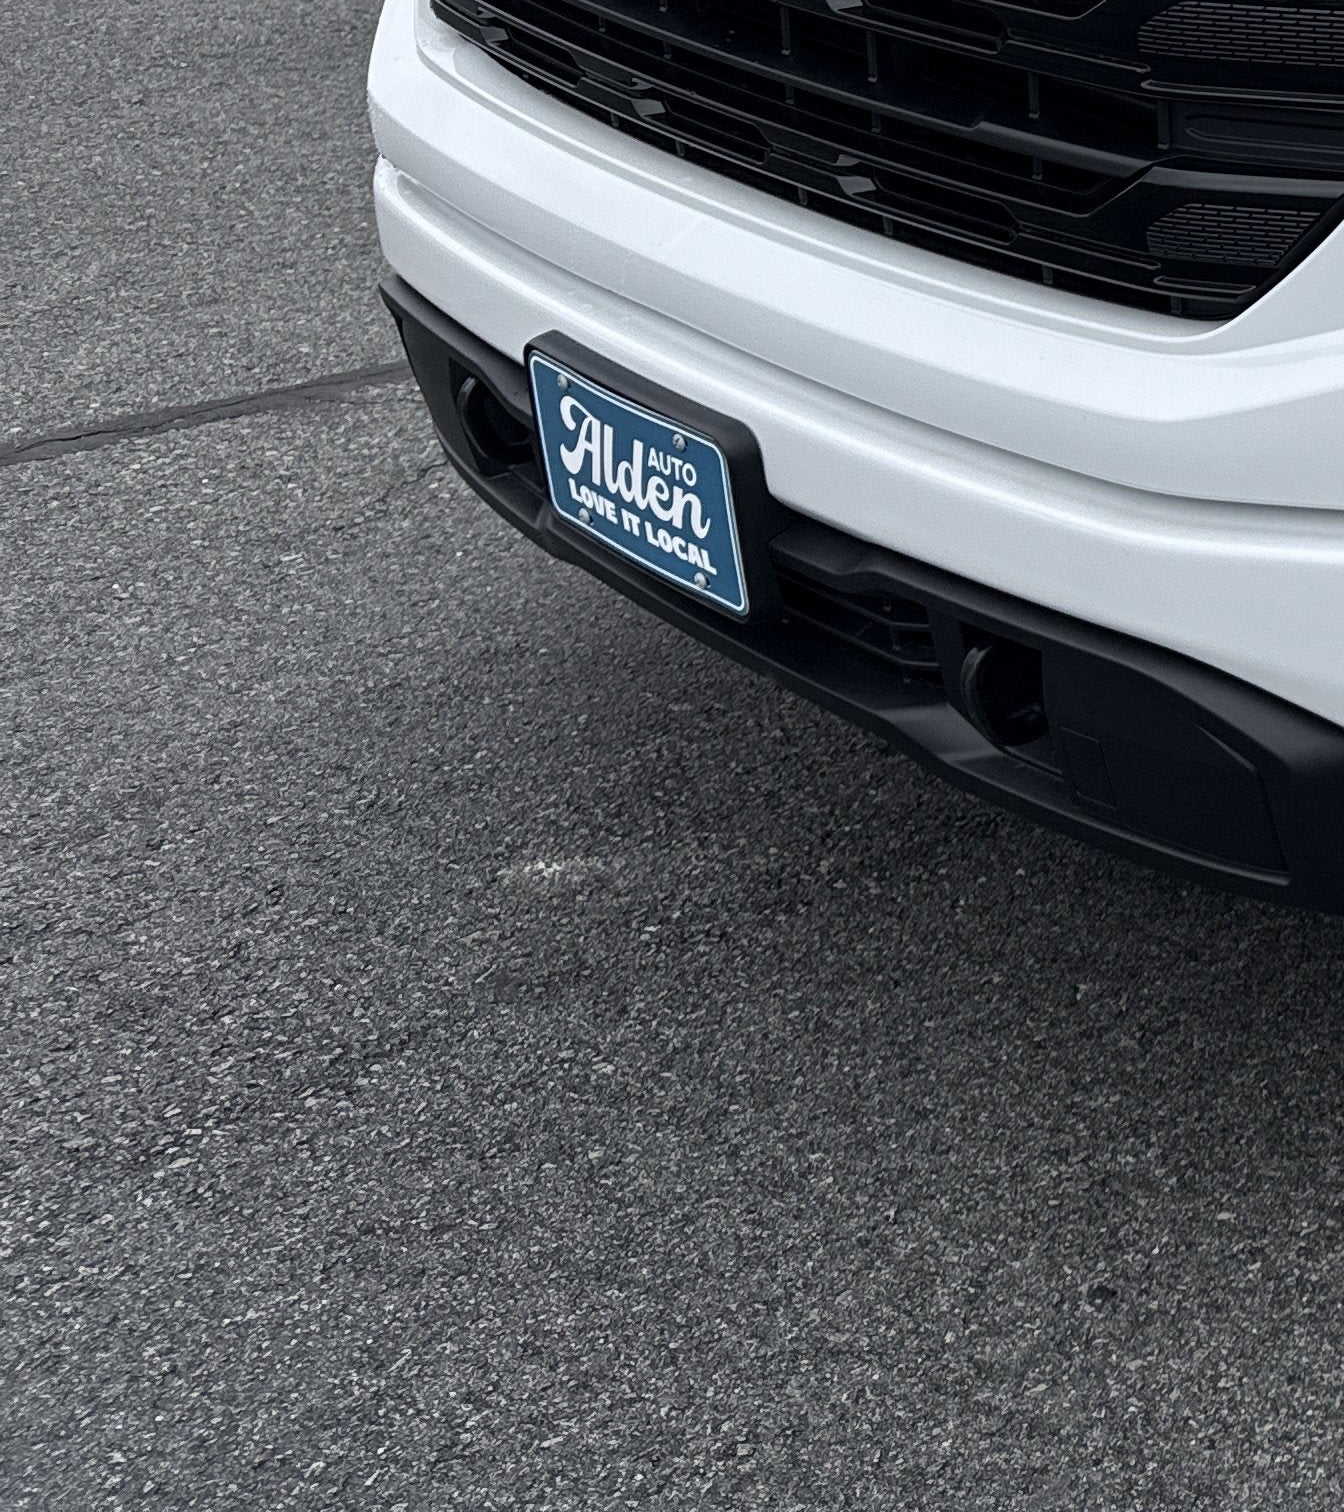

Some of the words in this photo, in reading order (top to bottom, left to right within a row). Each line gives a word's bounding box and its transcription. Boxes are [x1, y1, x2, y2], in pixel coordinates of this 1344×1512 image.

[559, 395, 711, 539] Alden
[647, 447, 697, 487] AUTO
[568, 477, 619, 525] LOVE
[621, 509, 641, 537] IT
[644, 520, 718, 576] LOCAL
